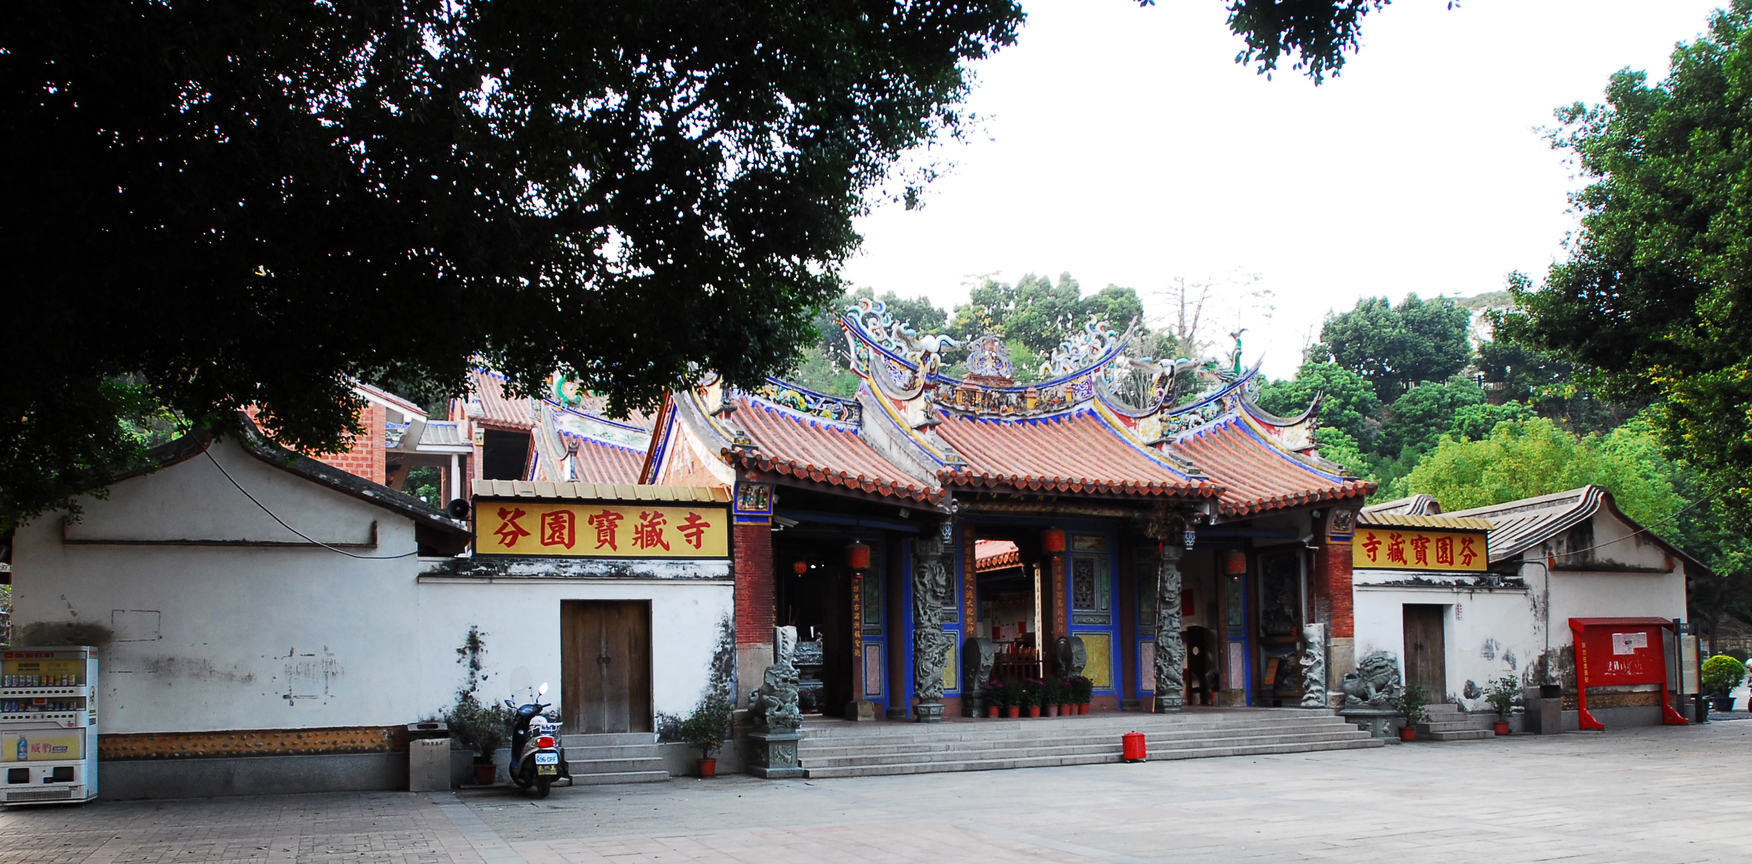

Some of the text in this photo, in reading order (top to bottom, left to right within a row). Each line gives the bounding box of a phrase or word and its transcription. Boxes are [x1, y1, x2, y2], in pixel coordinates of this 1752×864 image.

[493, 507, 711, 551] 芬園寶藏寺
